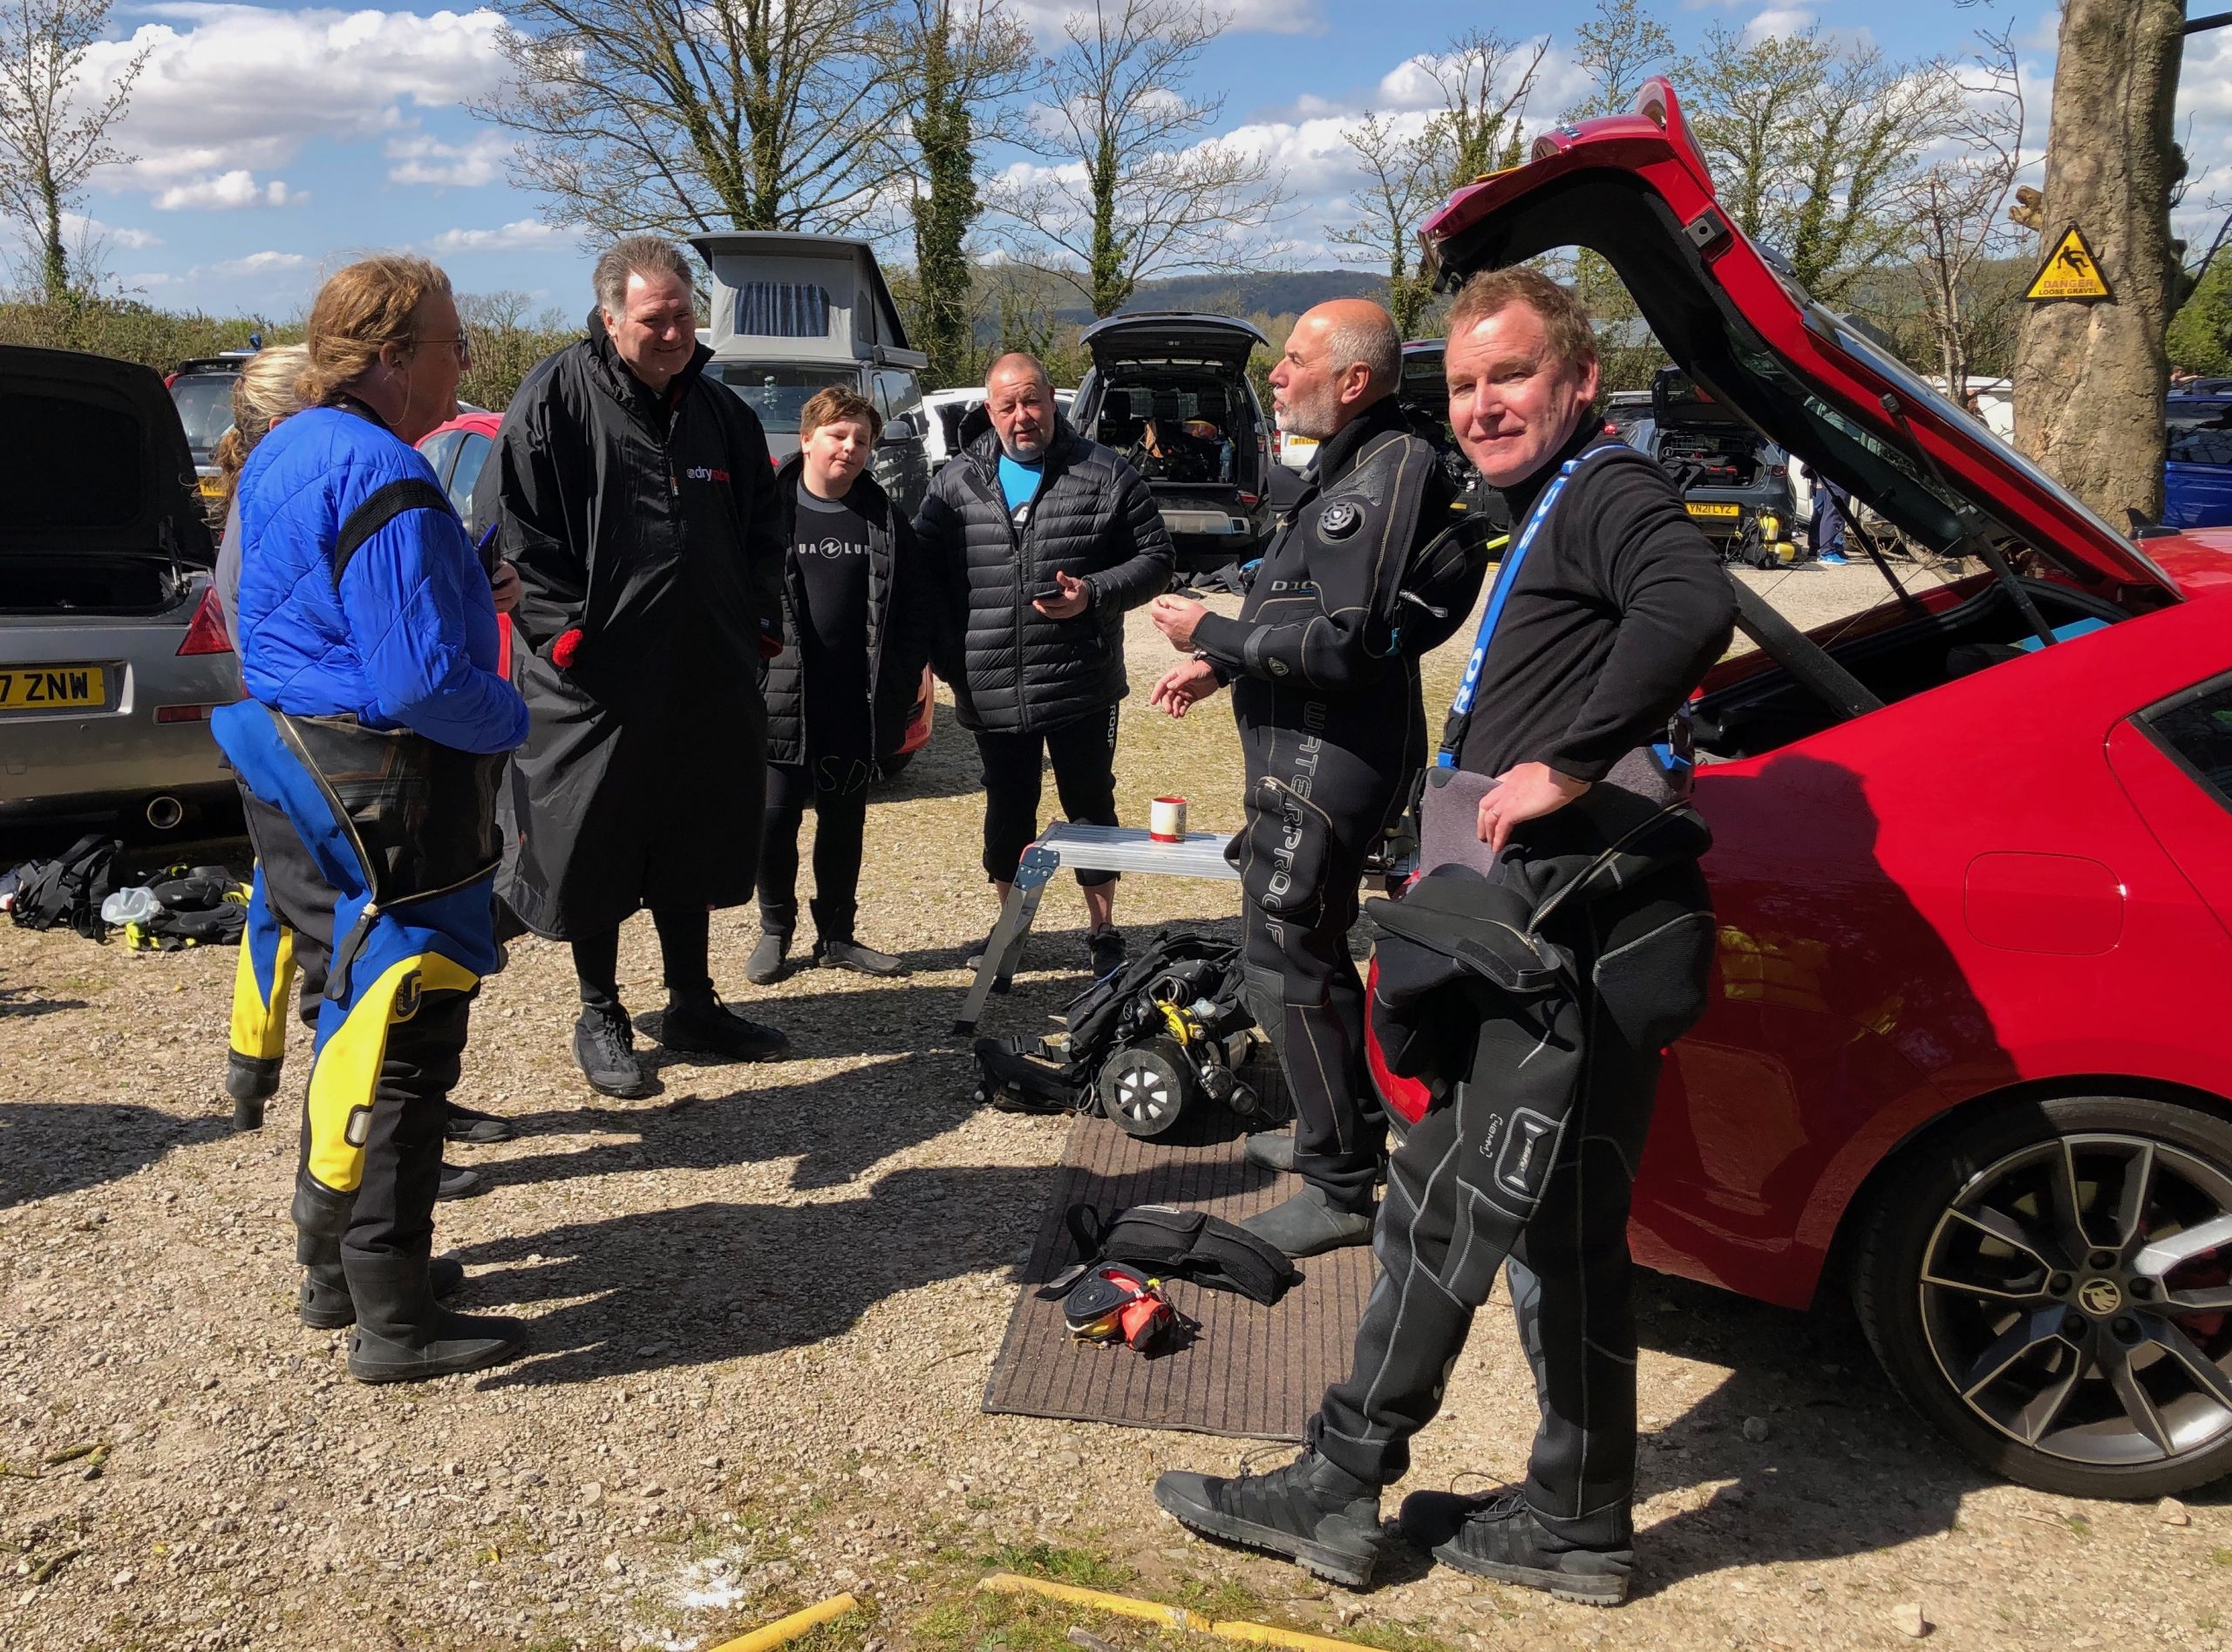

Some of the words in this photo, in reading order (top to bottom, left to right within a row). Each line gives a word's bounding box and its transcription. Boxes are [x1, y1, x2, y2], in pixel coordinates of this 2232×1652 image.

[2044, 280, 2094, 289] DANGER
[1689, 504, 1711, 513] YN21
[1712, 505, 1732, 514] LYZ
[24, 671, 88, 702] ZNW
[1106, 704, 1117, 749] ROOF
[1261, 700, 1327, 954] WATERPROOF
